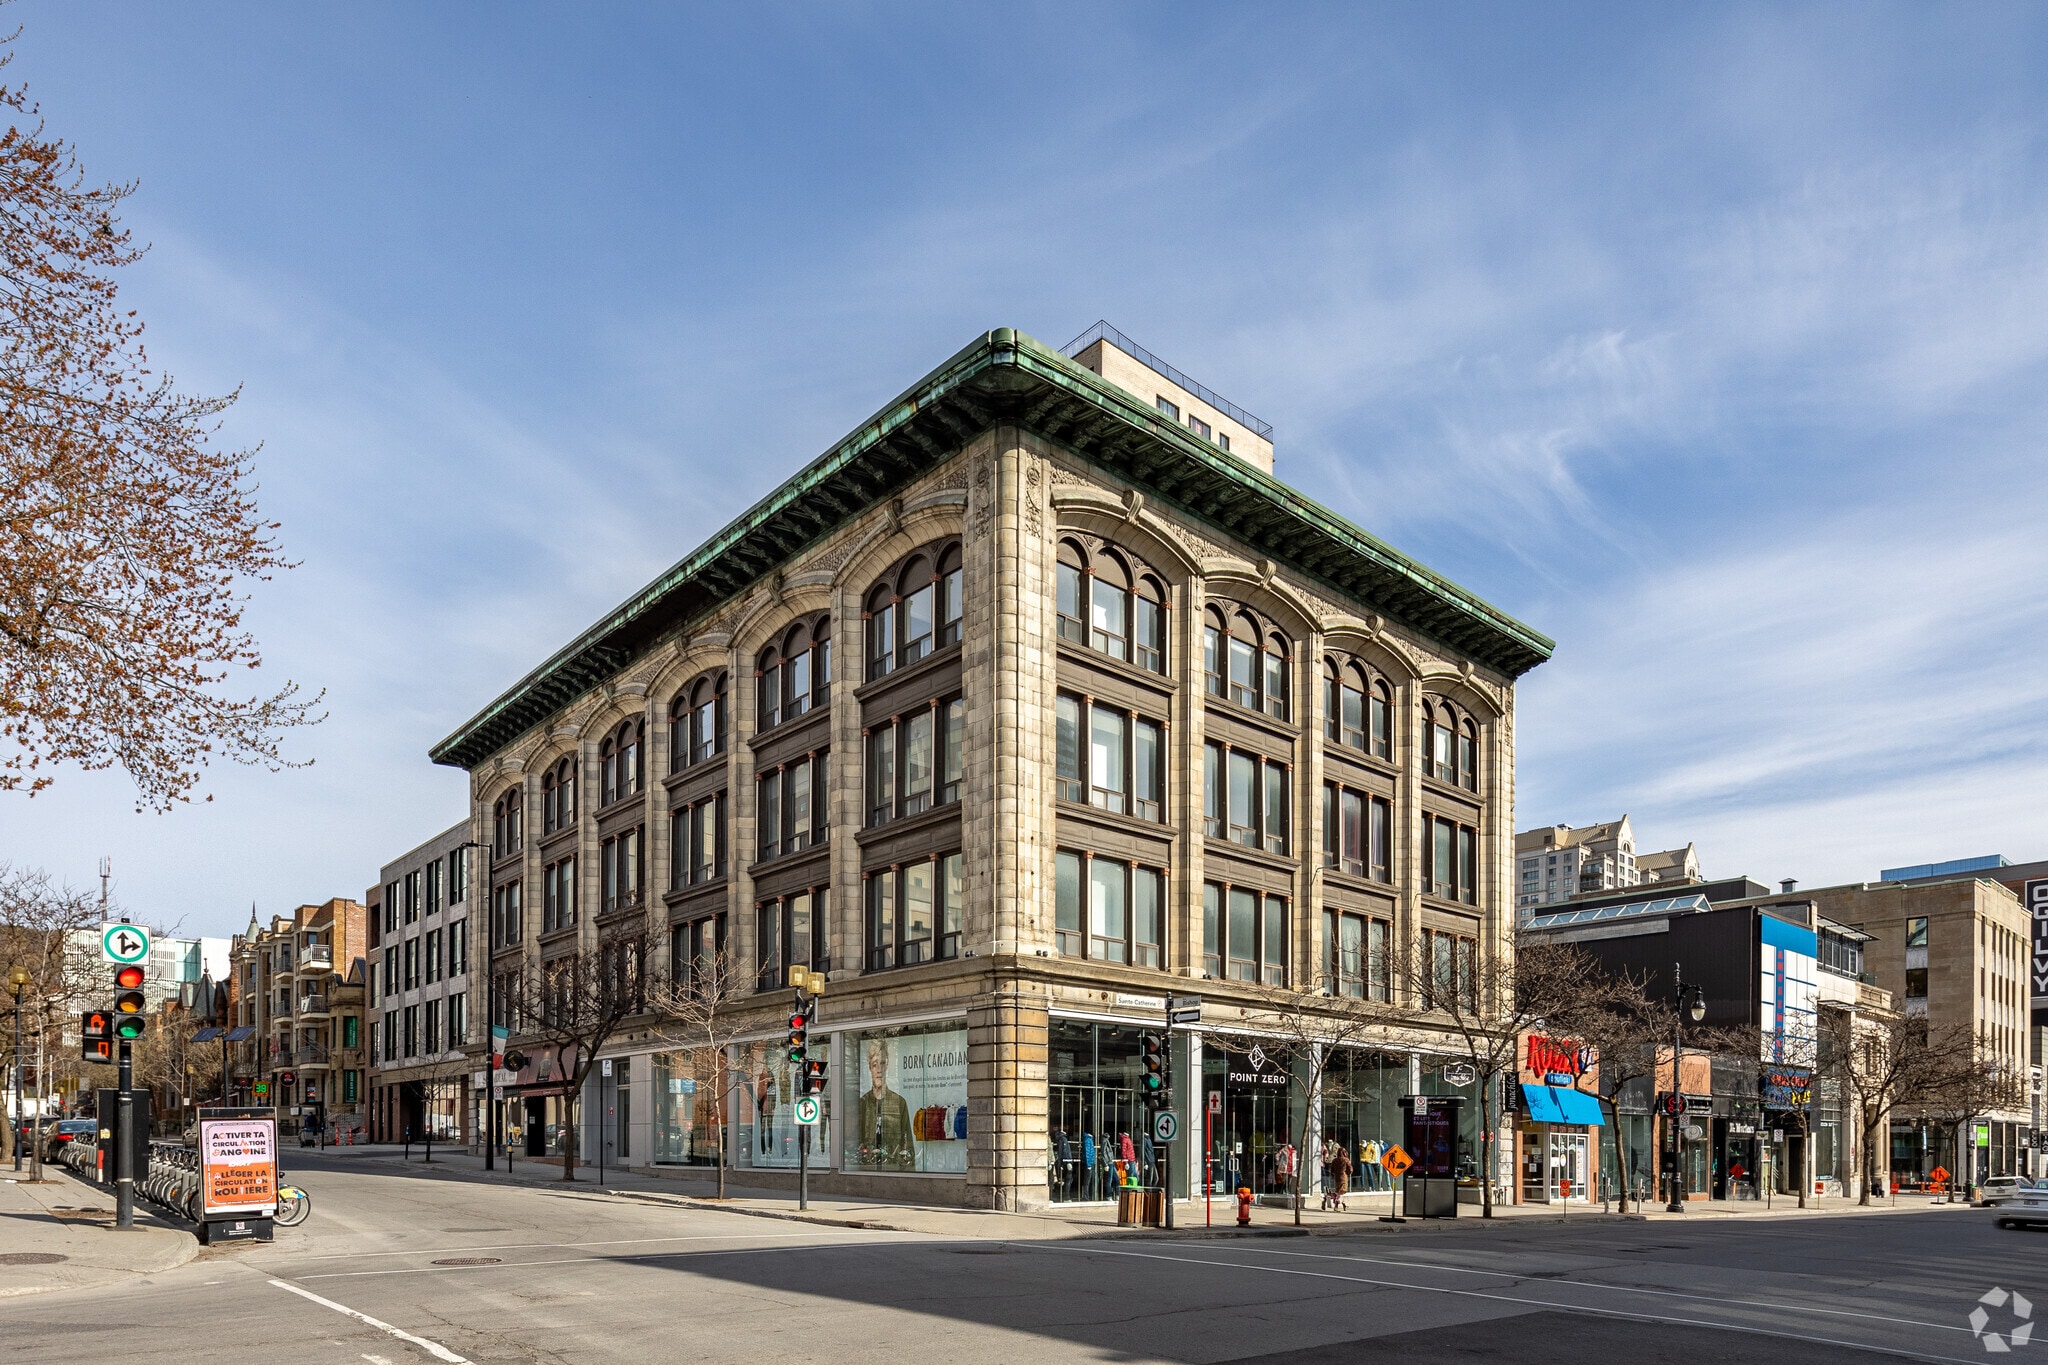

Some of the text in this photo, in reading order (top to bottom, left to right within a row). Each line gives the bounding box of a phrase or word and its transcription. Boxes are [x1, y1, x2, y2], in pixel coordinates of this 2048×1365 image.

[2032, 884, 2048, 992] OGILVY
[903, 1051, 968, 1070] BORN CANADIAN
[1230, 1072, 1286, 1084] POINT ZERO
